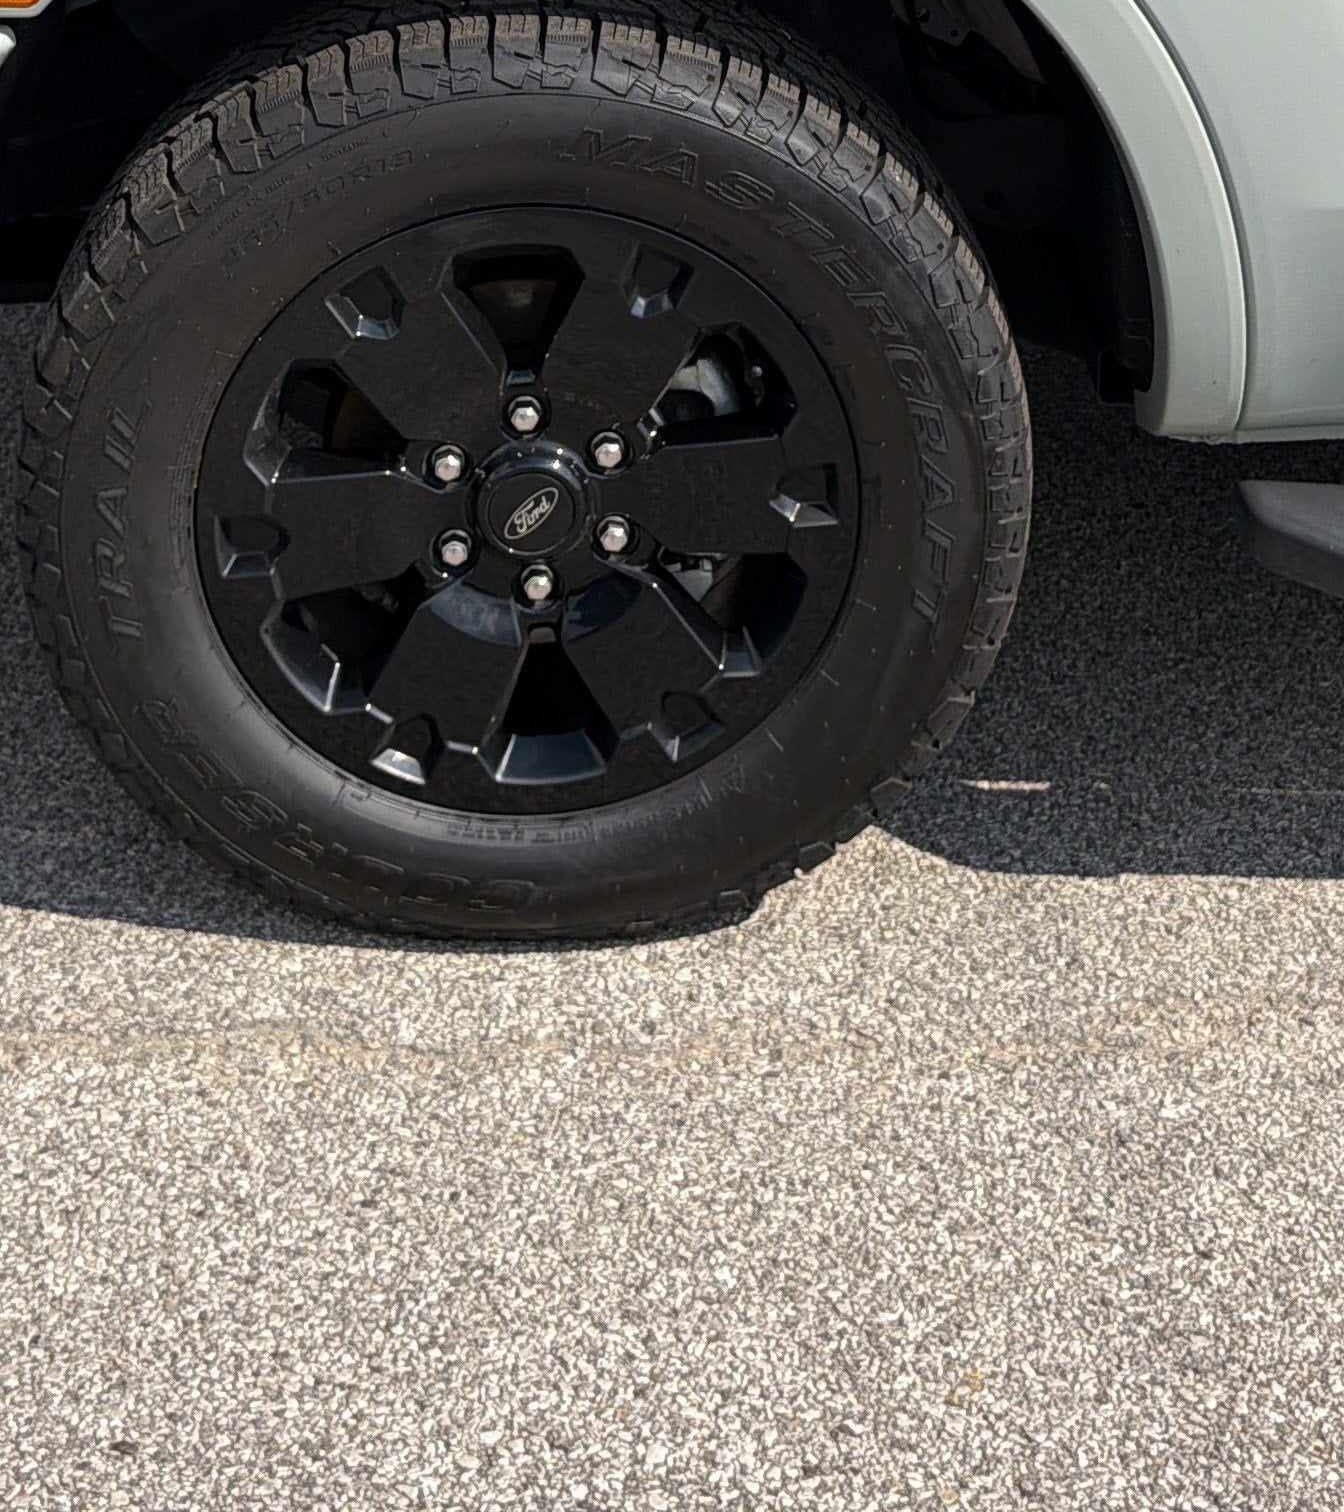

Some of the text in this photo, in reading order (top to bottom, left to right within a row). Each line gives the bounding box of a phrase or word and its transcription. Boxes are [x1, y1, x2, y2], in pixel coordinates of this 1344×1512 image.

[558, 128, 957, 644] MASTERCRAFT
[93, 400, 151, 639] TRAIL
[513, 495, 552, 533] Ford
